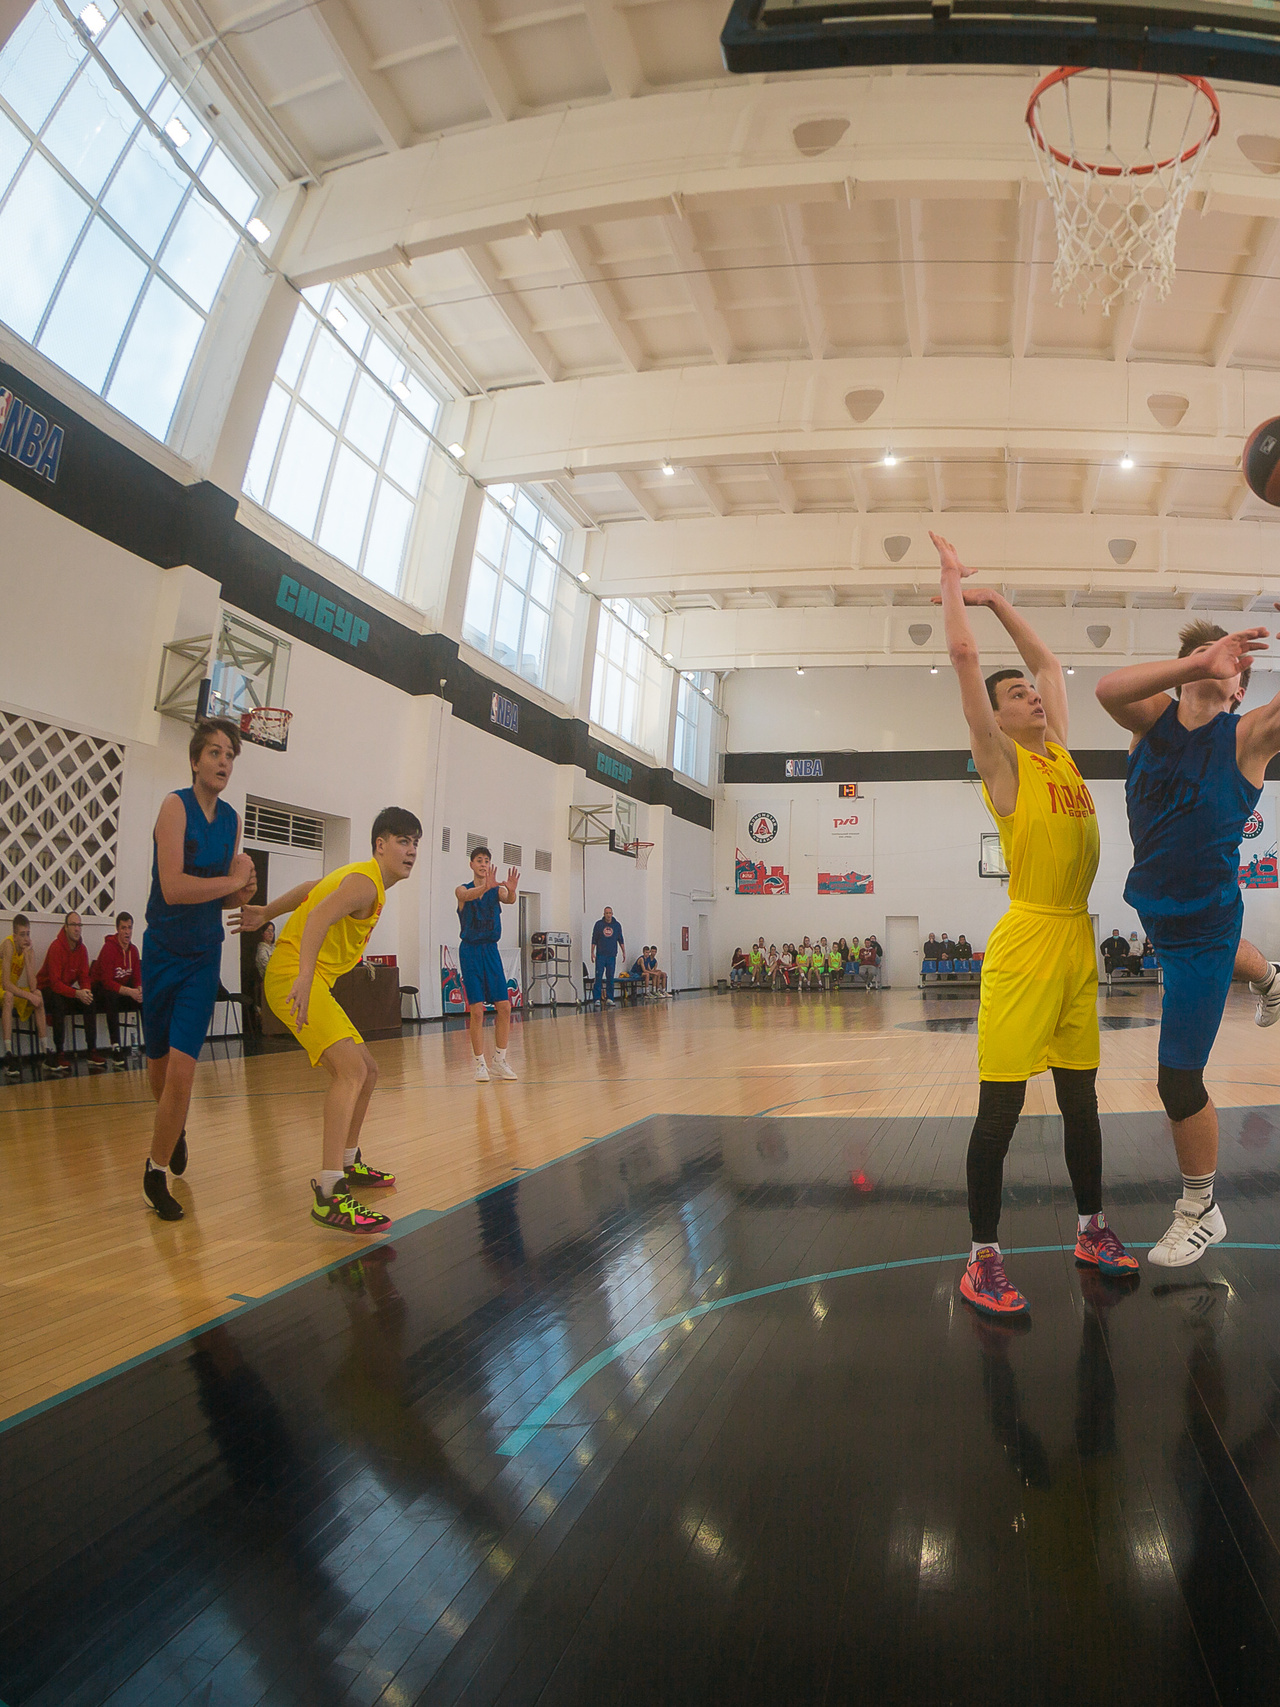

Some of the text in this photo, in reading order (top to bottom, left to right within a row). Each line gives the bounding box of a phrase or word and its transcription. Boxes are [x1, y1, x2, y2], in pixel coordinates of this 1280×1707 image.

[0, 396, 65, 484] NBA
[276, 574, 370, 647] СИБУР
[496, 695, 519, 734] NBA
[597, 752, 633, 784] СИБУР
[793, 759, 823, 777] NBA
